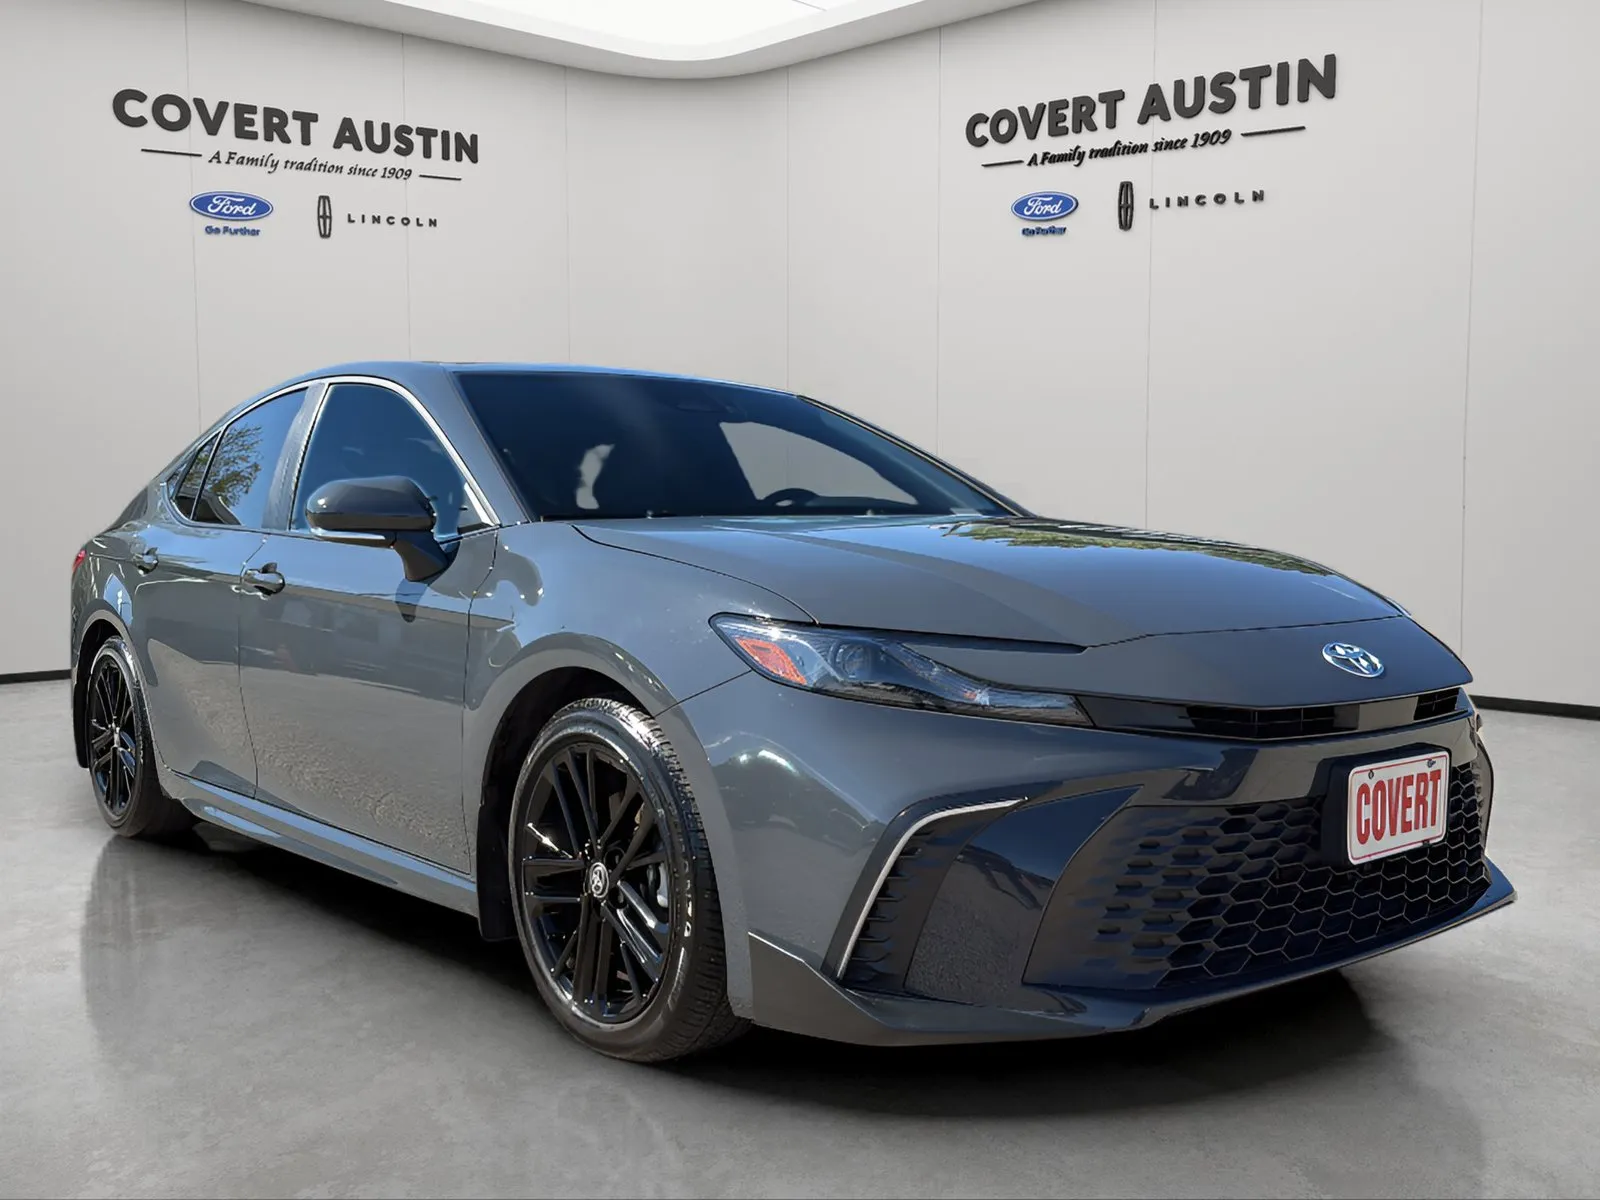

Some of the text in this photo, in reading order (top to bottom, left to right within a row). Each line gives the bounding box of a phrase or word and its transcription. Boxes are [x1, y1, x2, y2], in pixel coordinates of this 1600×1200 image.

[966, 53, 1337, 147] COVERT AUSTIN
[112, 88, 479, 164] COVERT AUSTIN
[1027, 128, 1232, 167] A Family tradition since 1909
[208, 150, 413, 181] A Family tradition since 1909
[207, 195, 257, 216] Ford
[1023, 196, 1063, 216] Ford
[1149, 189, 1265, 209] LINCOLN
[347, 213, 438, 228] LINCOLN
[1356, 769, 1442, 845] COVERT
